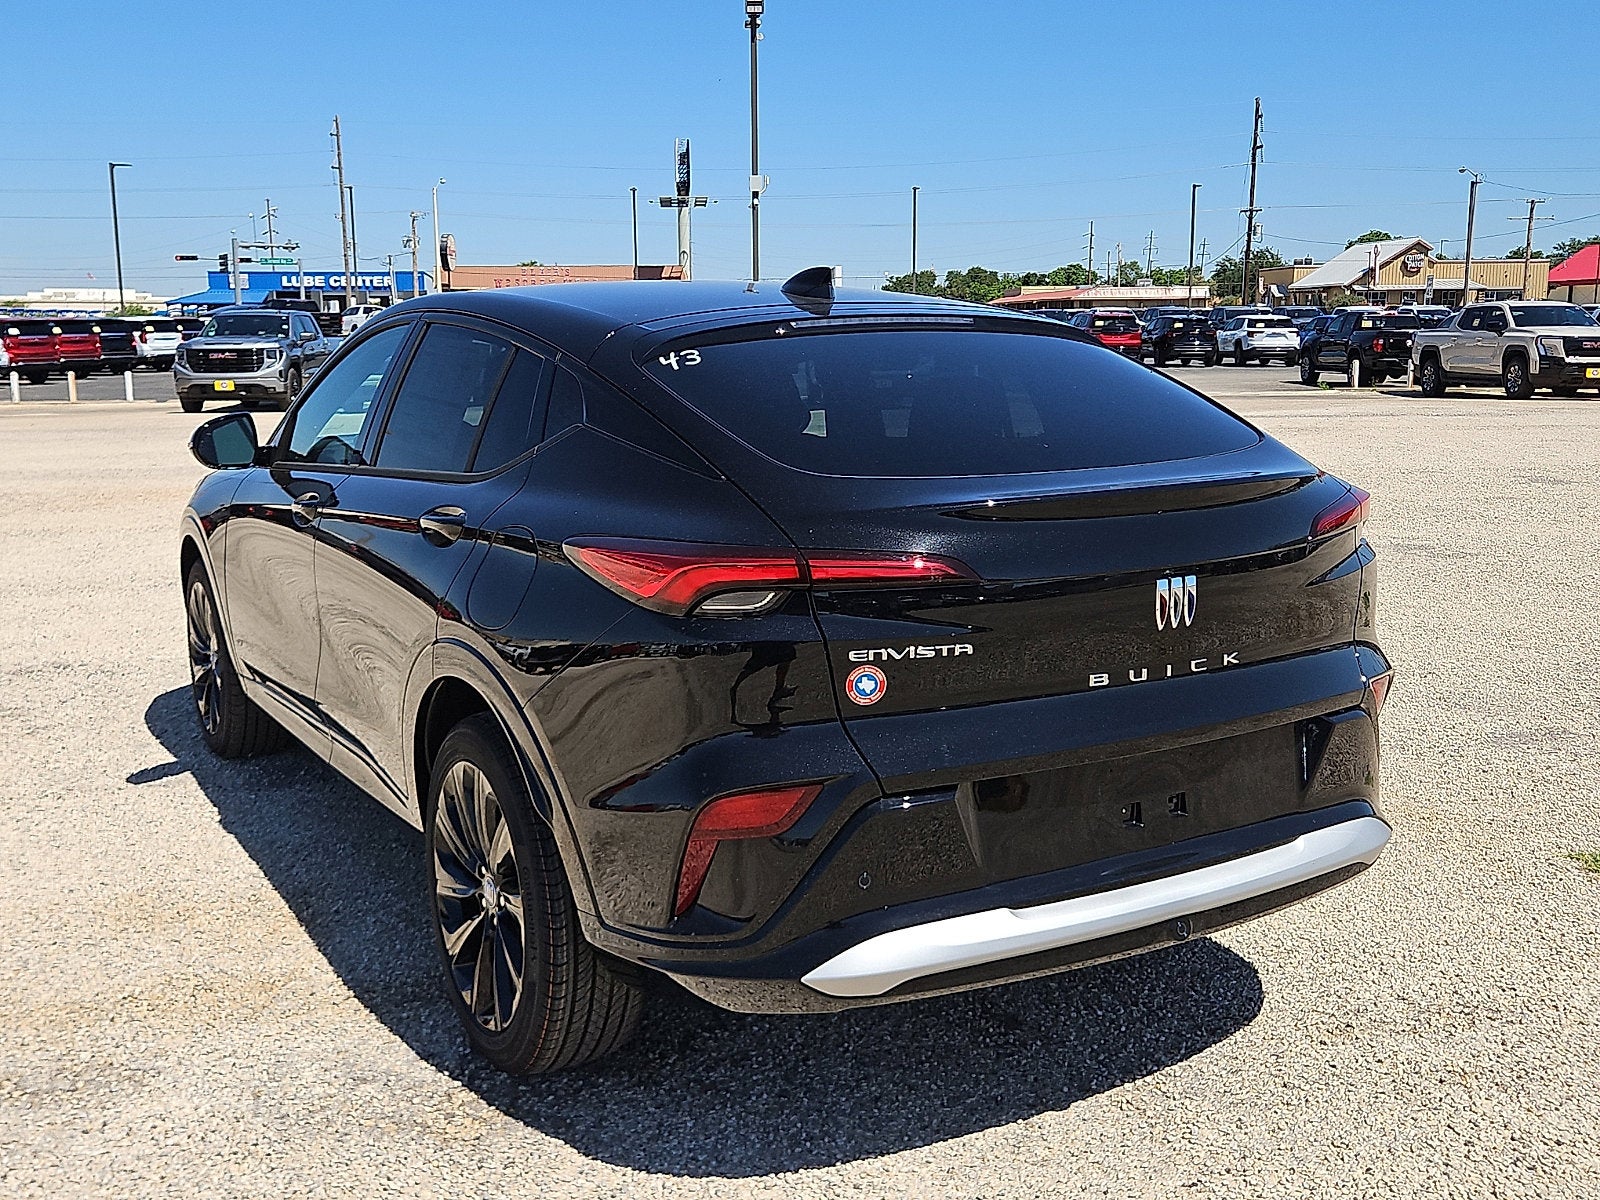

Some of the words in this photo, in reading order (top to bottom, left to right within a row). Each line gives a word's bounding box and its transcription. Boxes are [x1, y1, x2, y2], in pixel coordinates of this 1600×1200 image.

[1405, 253, 1424, 263] COTTON
[1408, 261, 1424, 270] PATCH
[281, 276, 325, 288] LUBE
[328, 276, 392, 288] CENTER
[1582, 341, 1600, 349] GM
[658, 349, 702, 371] 43
[848, 643, 975, 662] ENVISTA
[1089, 651, 1240, 687] BUICK
